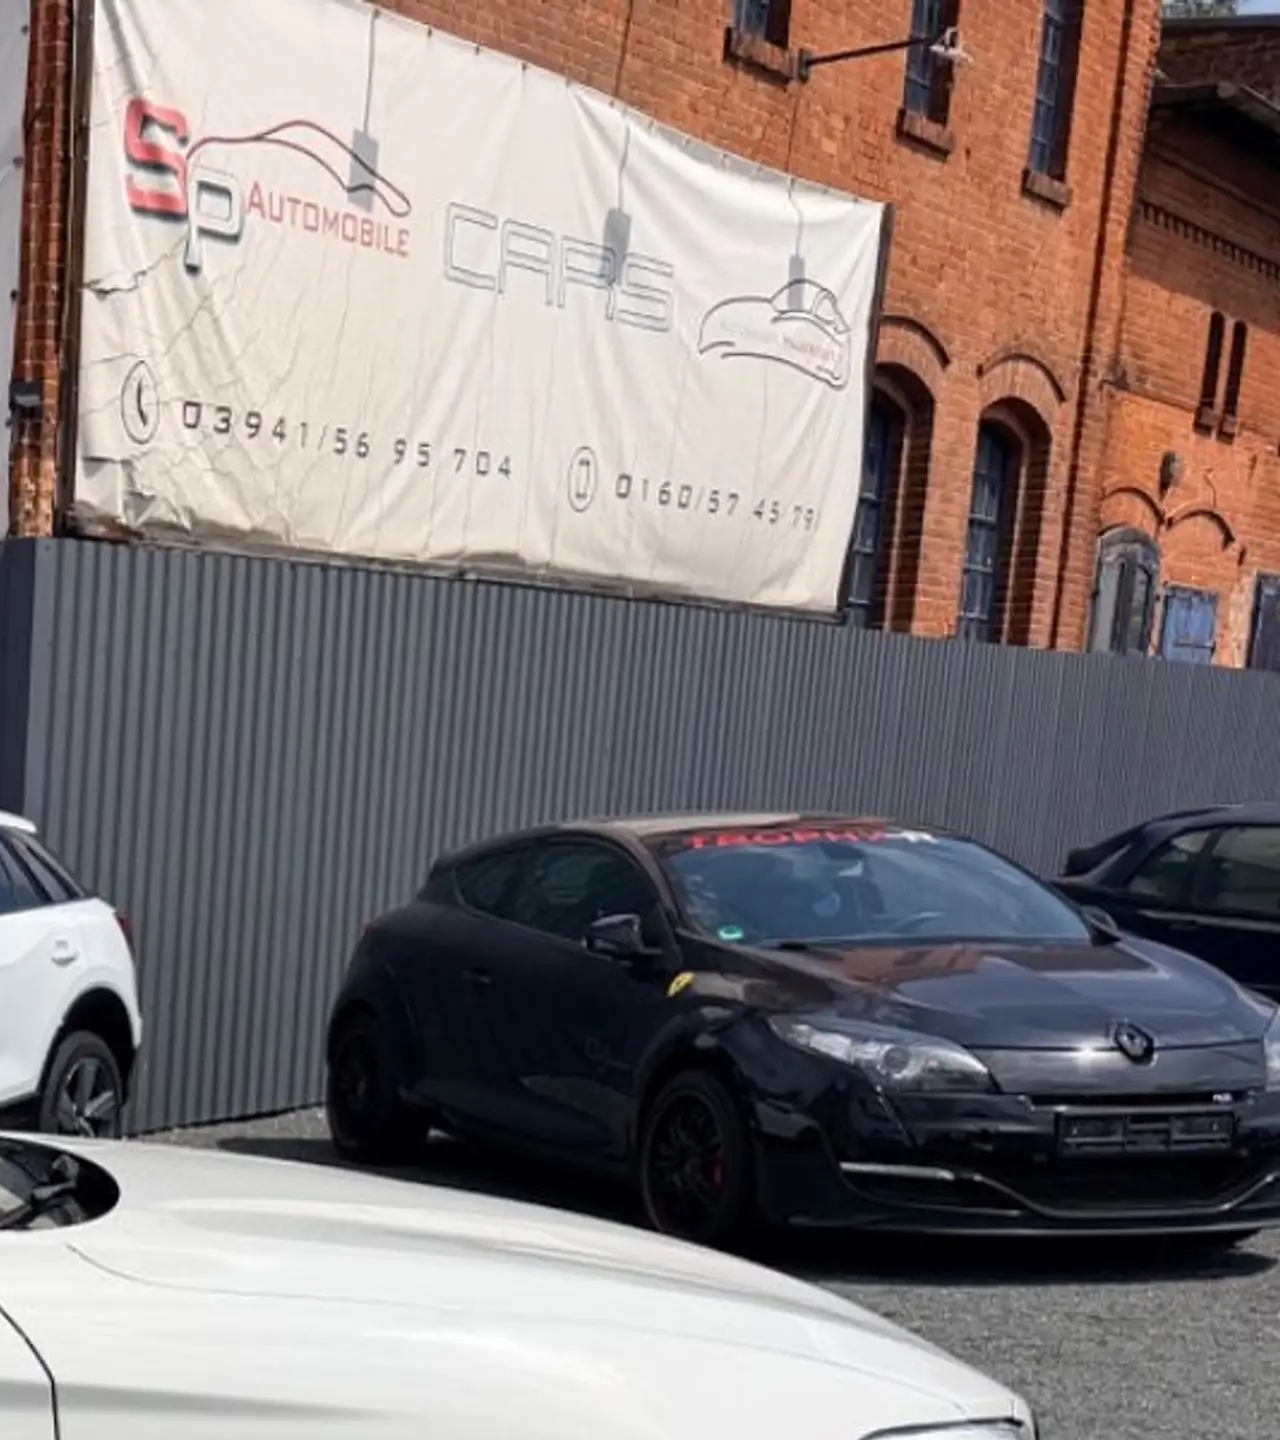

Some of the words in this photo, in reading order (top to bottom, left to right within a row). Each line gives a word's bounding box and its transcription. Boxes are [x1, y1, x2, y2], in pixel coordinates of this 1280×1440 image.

[247, 180, 411, 258] AUTOMOBILE
[444, 202, 675, 332] CARS
[182, 400, 371, 460] 03941/56
[392, 437, 432, 468] 95
[453, 446, 512, 479] 704
[614, 473, 741, 515] 0160/57
